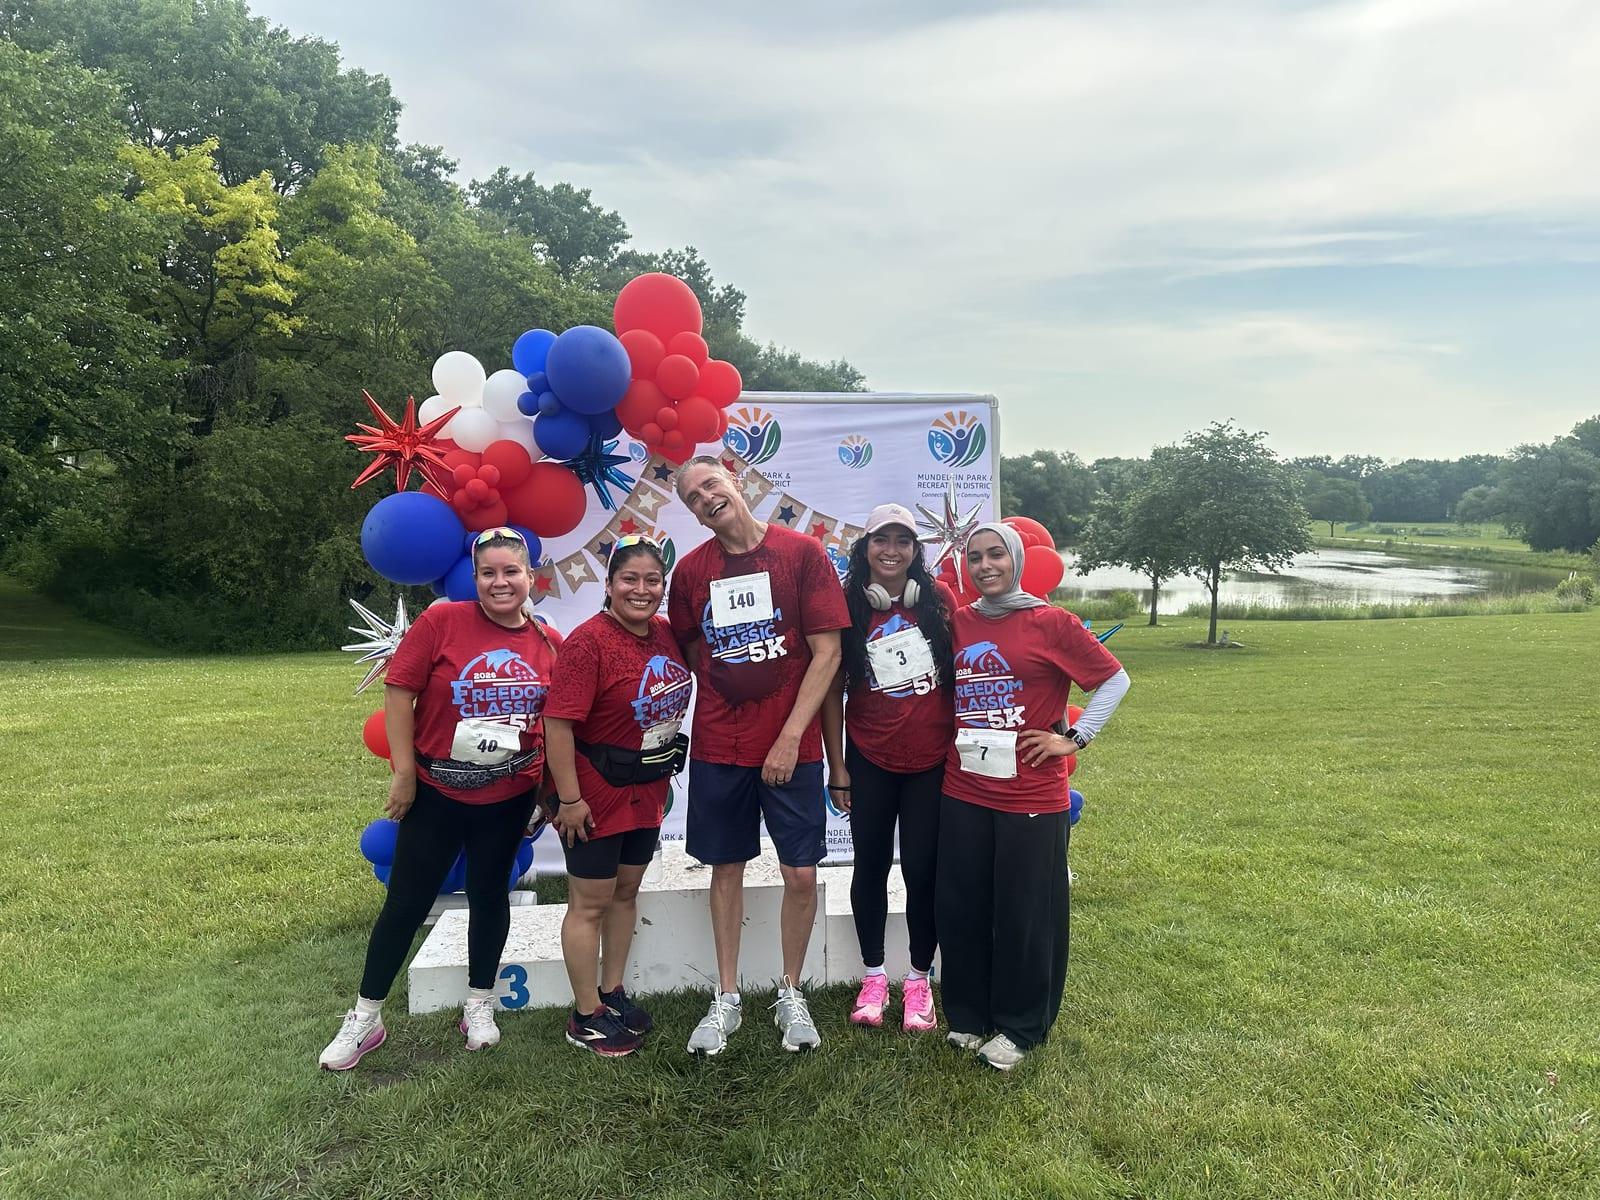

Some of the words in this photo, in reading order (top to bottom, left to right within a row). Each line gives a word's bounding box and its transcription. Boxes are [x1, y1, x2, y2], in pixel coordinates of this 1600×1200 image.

[960, 492, 991, 500] Community
[728, 591, 755, 610] 140
[747, 635, 788, 662] 5K
[895, 650, 907, 666] 3
[473, 671, 497, 680] 2026
[955, 680, 1024, 698] REEDOM
[630, 685, 691, 721] FREEDO
[987, 705, 1026, 729] 5K
[477, 739, 498, 753] 40
[980, 746, 989, 761] 7
[677, 833, 684, 841] &
[499, 964, 531, 1009] 3
